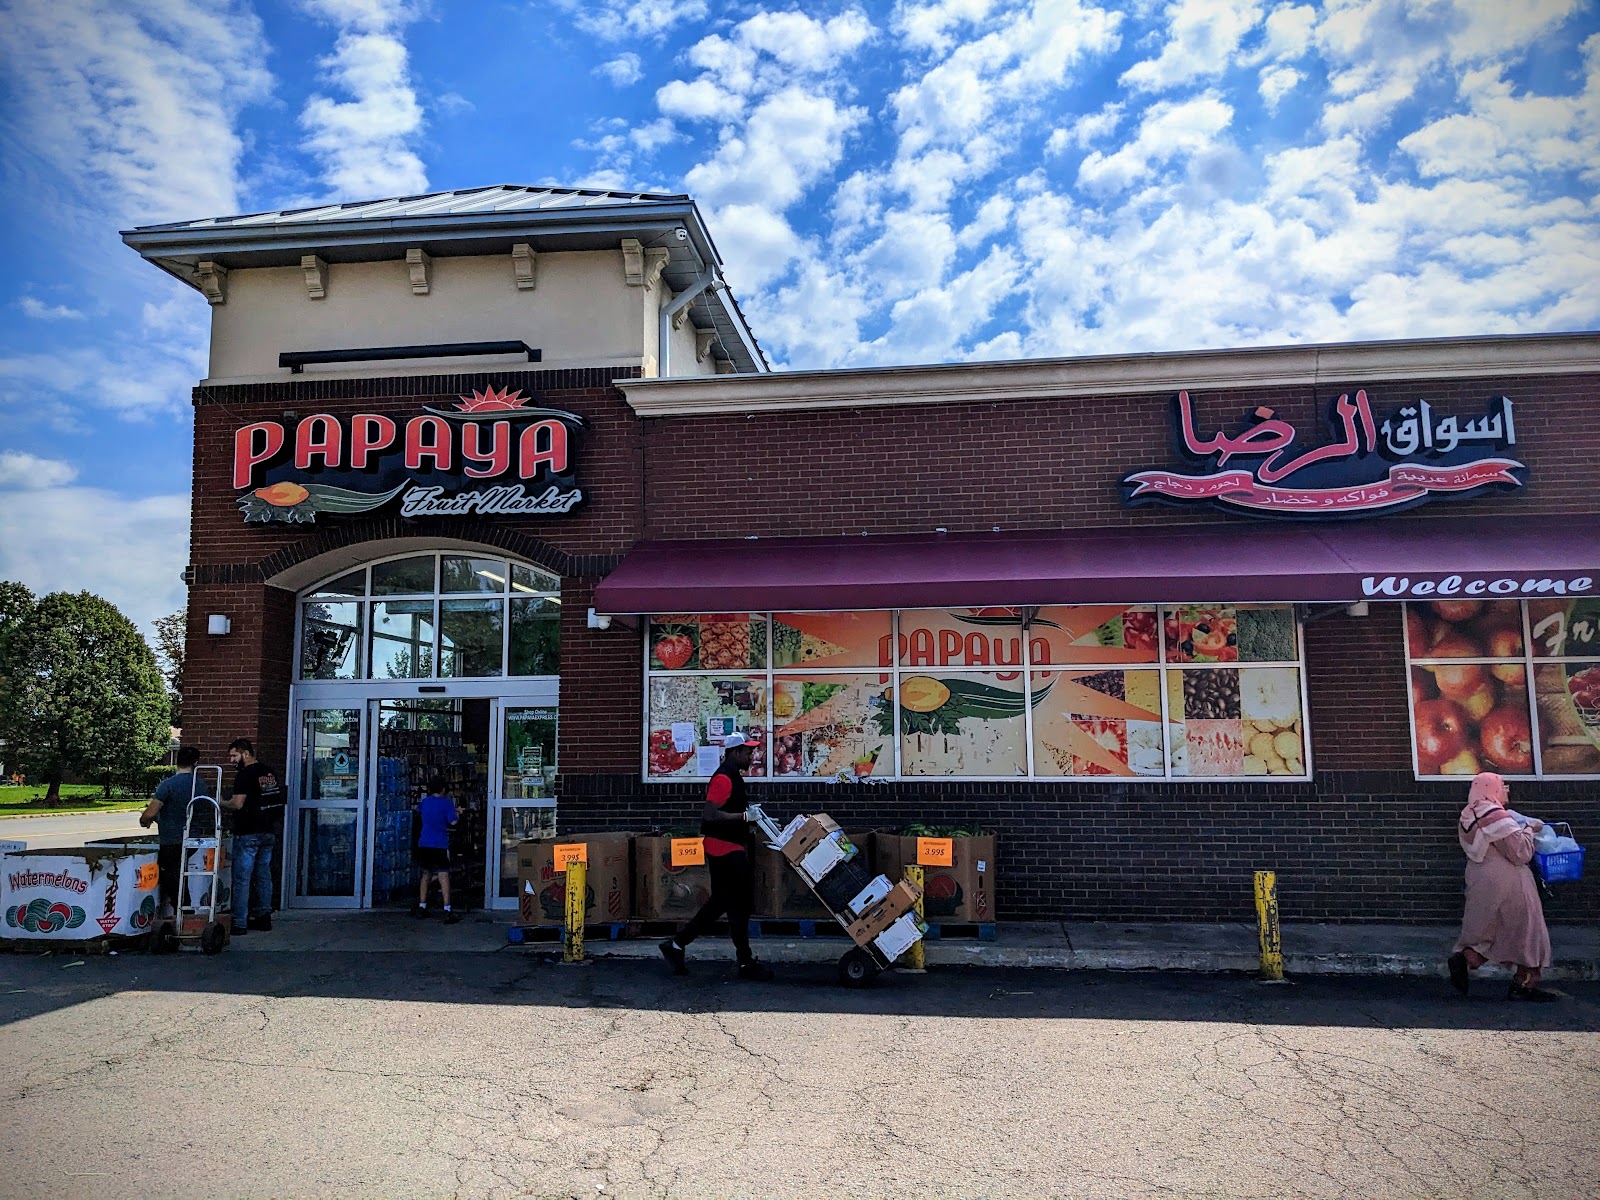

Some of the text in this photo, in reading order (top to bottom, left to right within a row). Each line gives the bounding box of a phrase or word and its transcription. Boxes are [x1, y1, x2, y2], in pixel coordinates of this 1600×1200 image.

[1381, 396, 1515, 455] اسواق
[233, 413, 569, 490] PAPAYA
[402, 484, 581, 515] Fruit Market
[1361, 575, 1593, 596] Welcome
[878, 628, 1051, 685] PAPAYA
[561, 853, 580, 861] 3.99$
[678, 848, 697, 856] 3.99$
[924, 848, 945, 856] 3.99$
[8, 867, 90, 895] Watermelons
